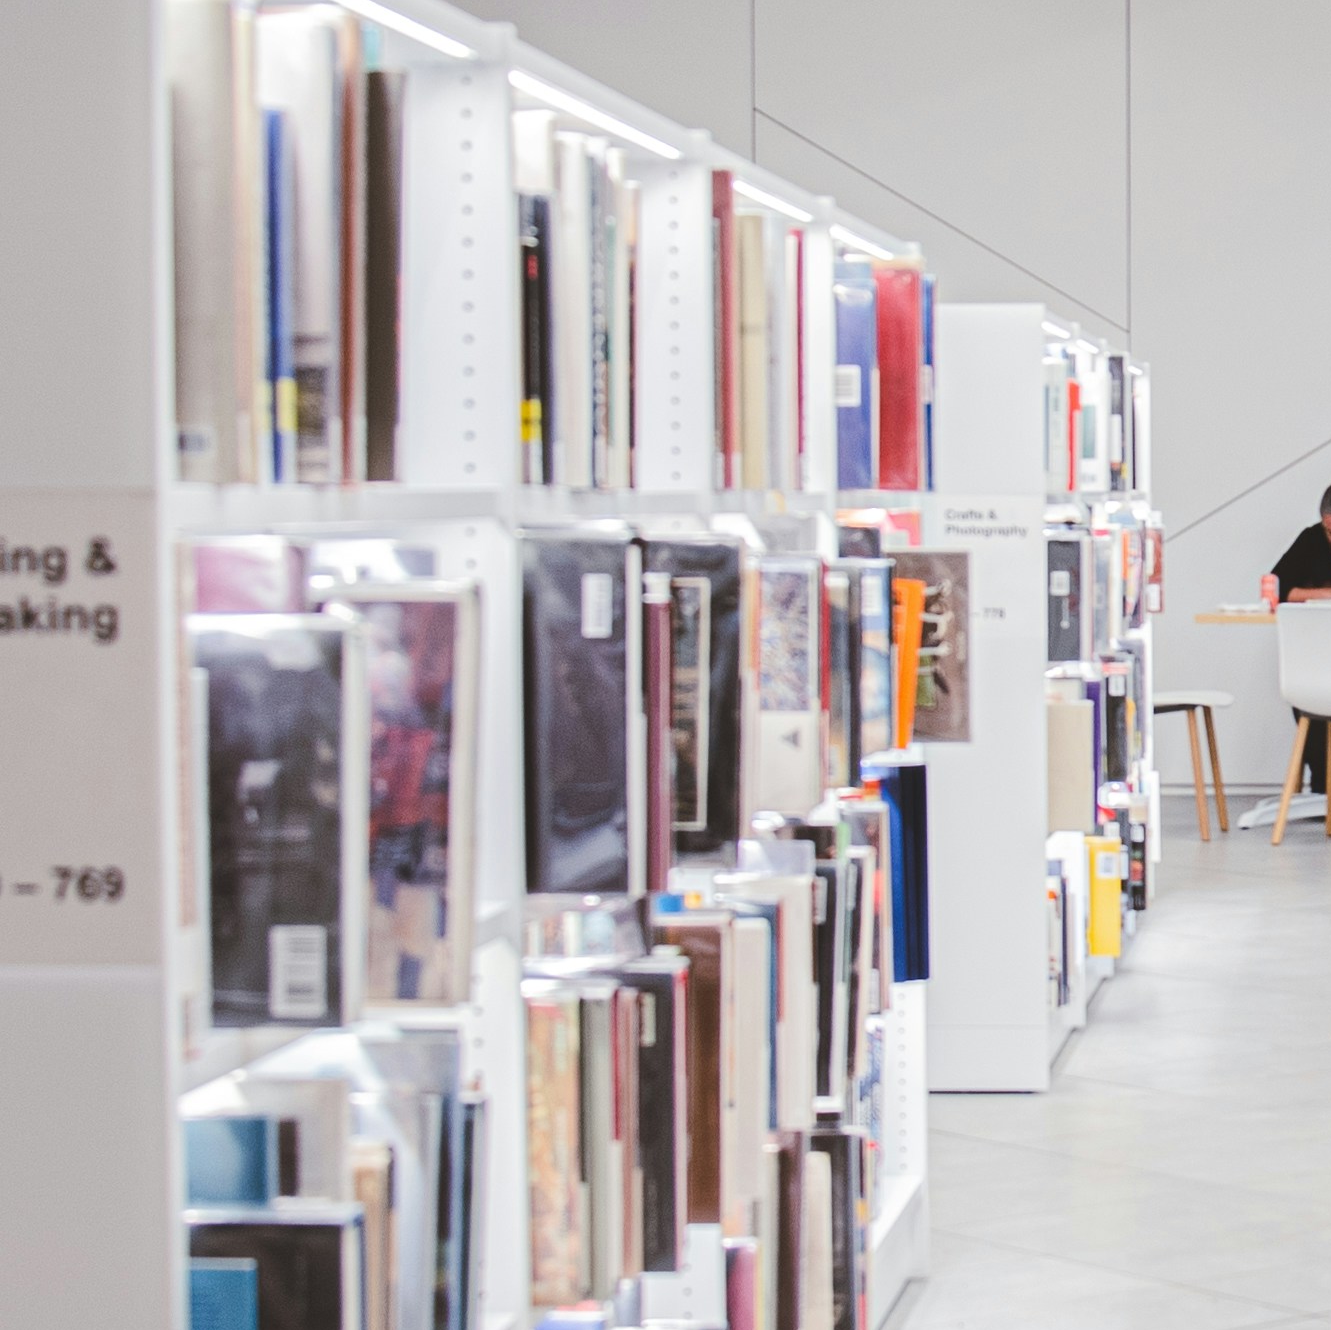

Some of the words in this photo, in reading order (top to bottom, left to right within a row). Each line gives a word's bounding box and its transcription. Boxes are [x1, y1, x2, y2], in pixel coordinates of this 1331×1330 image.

[944, 509, 984, 520] Crafts
[988, 509, 998, 520] &
[944, 524, 1028, 538] Photography
[86, 537, 116, 574] &
[53, 865, 124, 903] 769
